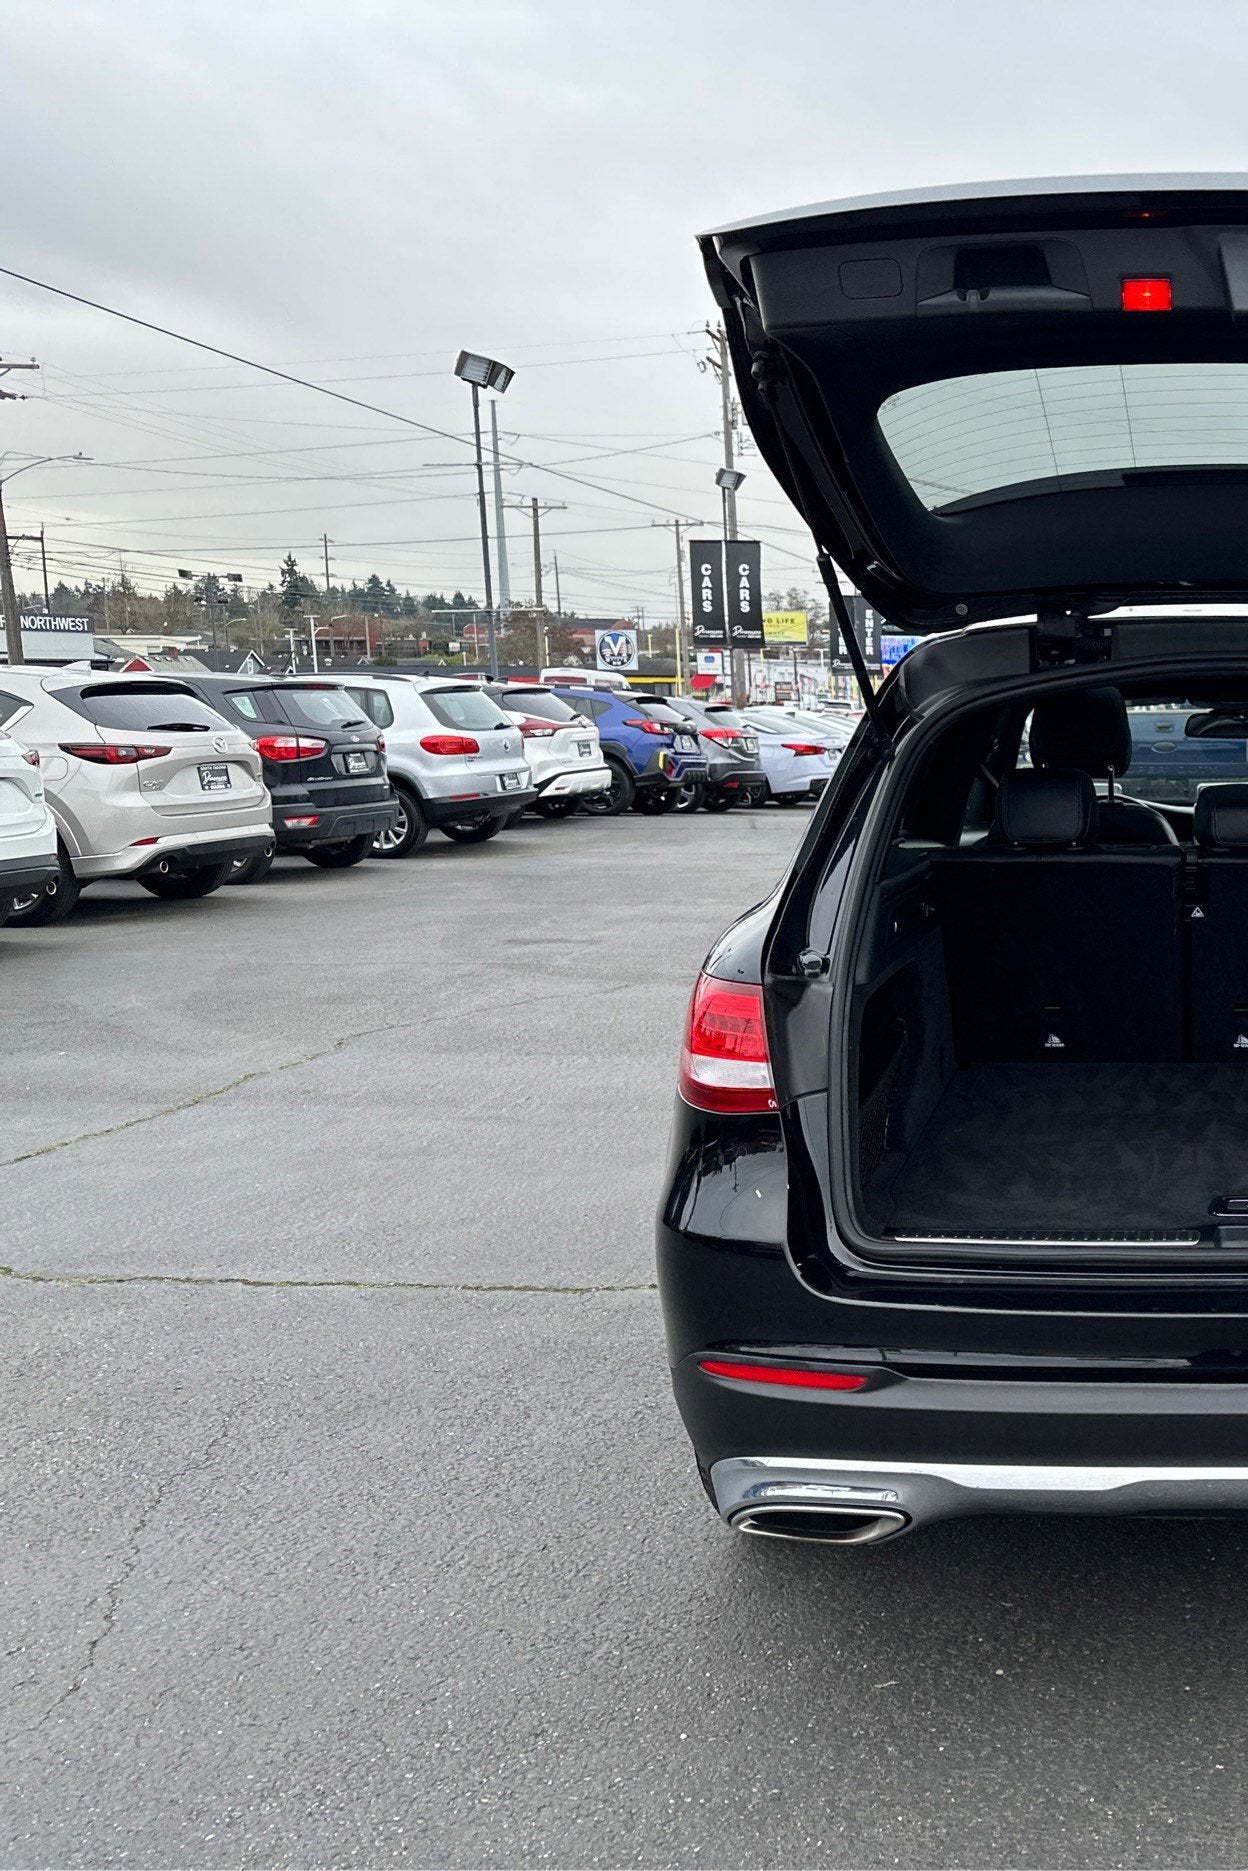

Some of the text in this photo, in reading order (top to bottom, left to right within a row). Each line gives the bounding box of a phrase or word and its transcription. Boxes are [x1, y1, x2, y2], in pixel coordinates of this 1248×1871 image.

[701, 563, 713, 613] CARS
[738, 563, 751, 613] CARS
[20, 615, 89, 631] NORTHWEST
[865, 609, 874, 655] ENTER
